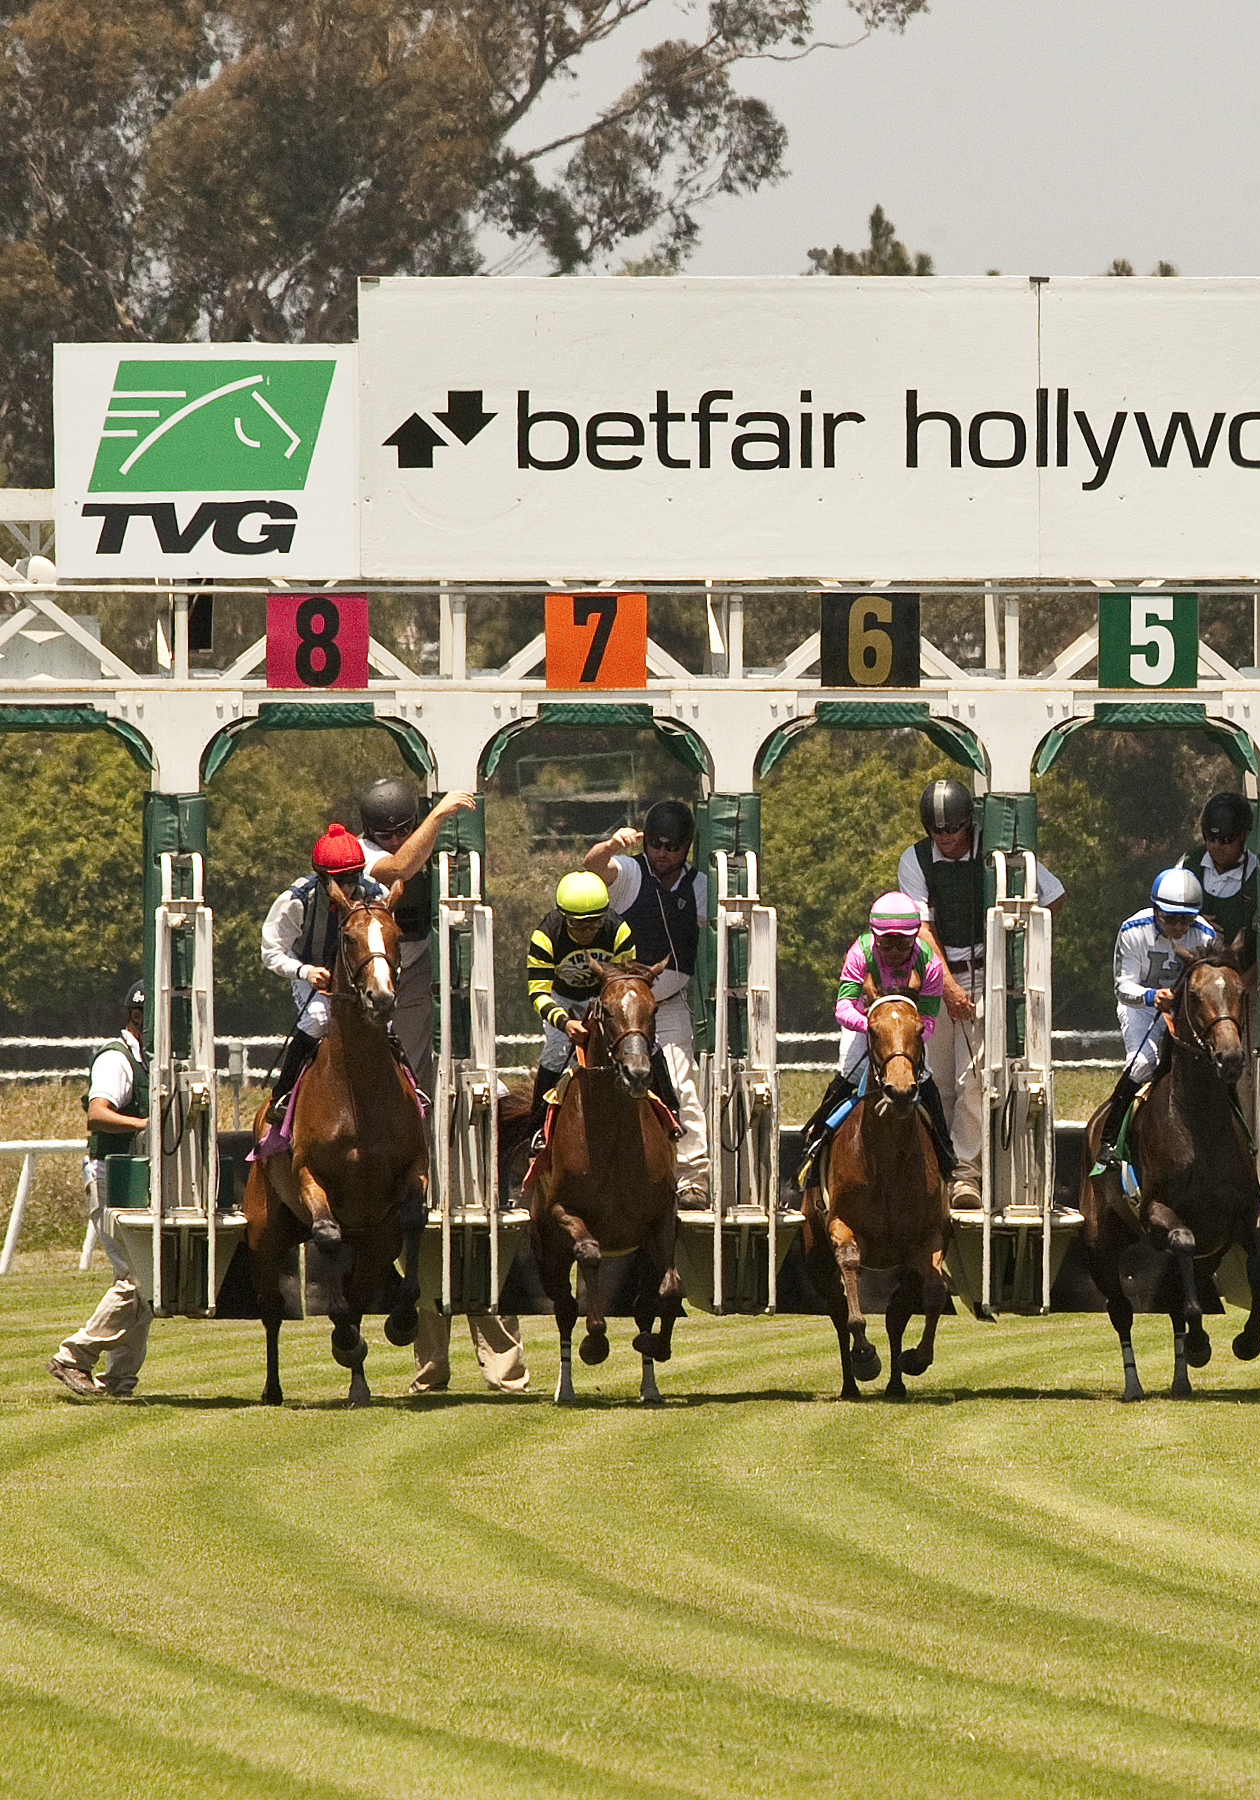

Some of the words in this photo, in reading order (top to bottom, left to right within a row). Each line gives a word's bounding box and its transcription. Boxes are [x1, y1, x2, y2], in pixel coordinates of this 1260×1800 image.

[517, 389, 866, 471] betfair
[81, 499, 298, 555] TVG
[295, 597, 342, 687] 8
[572, 595, 618, 683] 7
[847, 595, 893, 687] 6
[1129, 595, 1176, 686] 5
[568, 952, 613, 965] TRPLE
